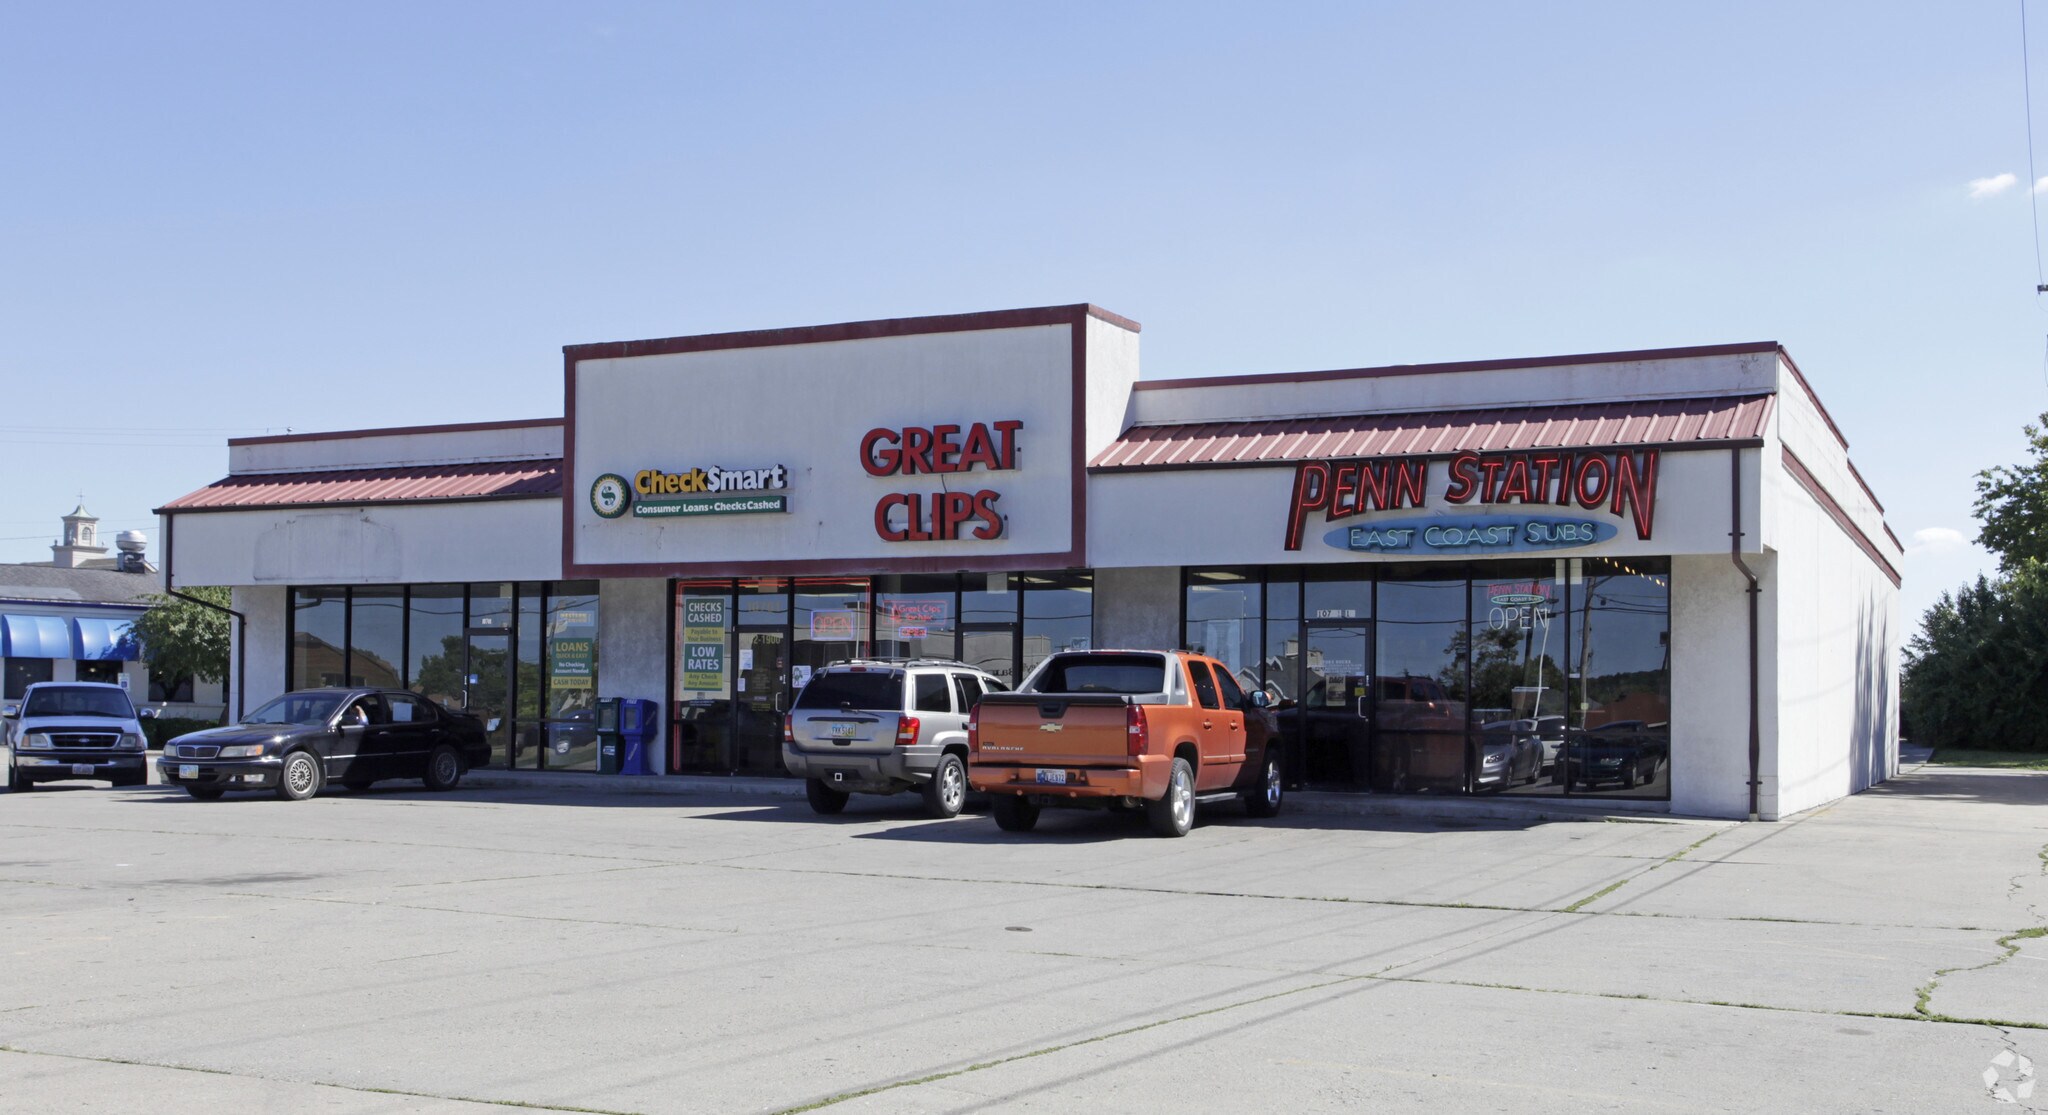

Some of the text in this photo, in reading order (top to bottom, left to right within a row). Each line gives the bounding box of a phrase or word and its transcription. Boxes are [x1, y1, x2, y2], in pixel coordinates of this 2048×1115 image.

[860, 420, 1023, 476] GREAT
[1284, 449, 1661, 551] PENN STATION
[636, 504, 681, 514] Consumer
[683, 503, 709, 512] Loans
[874, 490, 1003, 541] CLIPS
[1350, 522, 1596, 548] EAST COAST SUBS
[1487, 583, 1551, 599] PENN STATION
[688, 602, 722, 612] CHECKS
[688, 613, 722, 622] CASHED
[814, 616, 852, 633] OPEN
[1489, 607, 1548, 630] OPEN
[555, 642, 589, 652] LOANS
[692, 646, 716, 657] LOW
[688, 659, 719, 670] RATES
